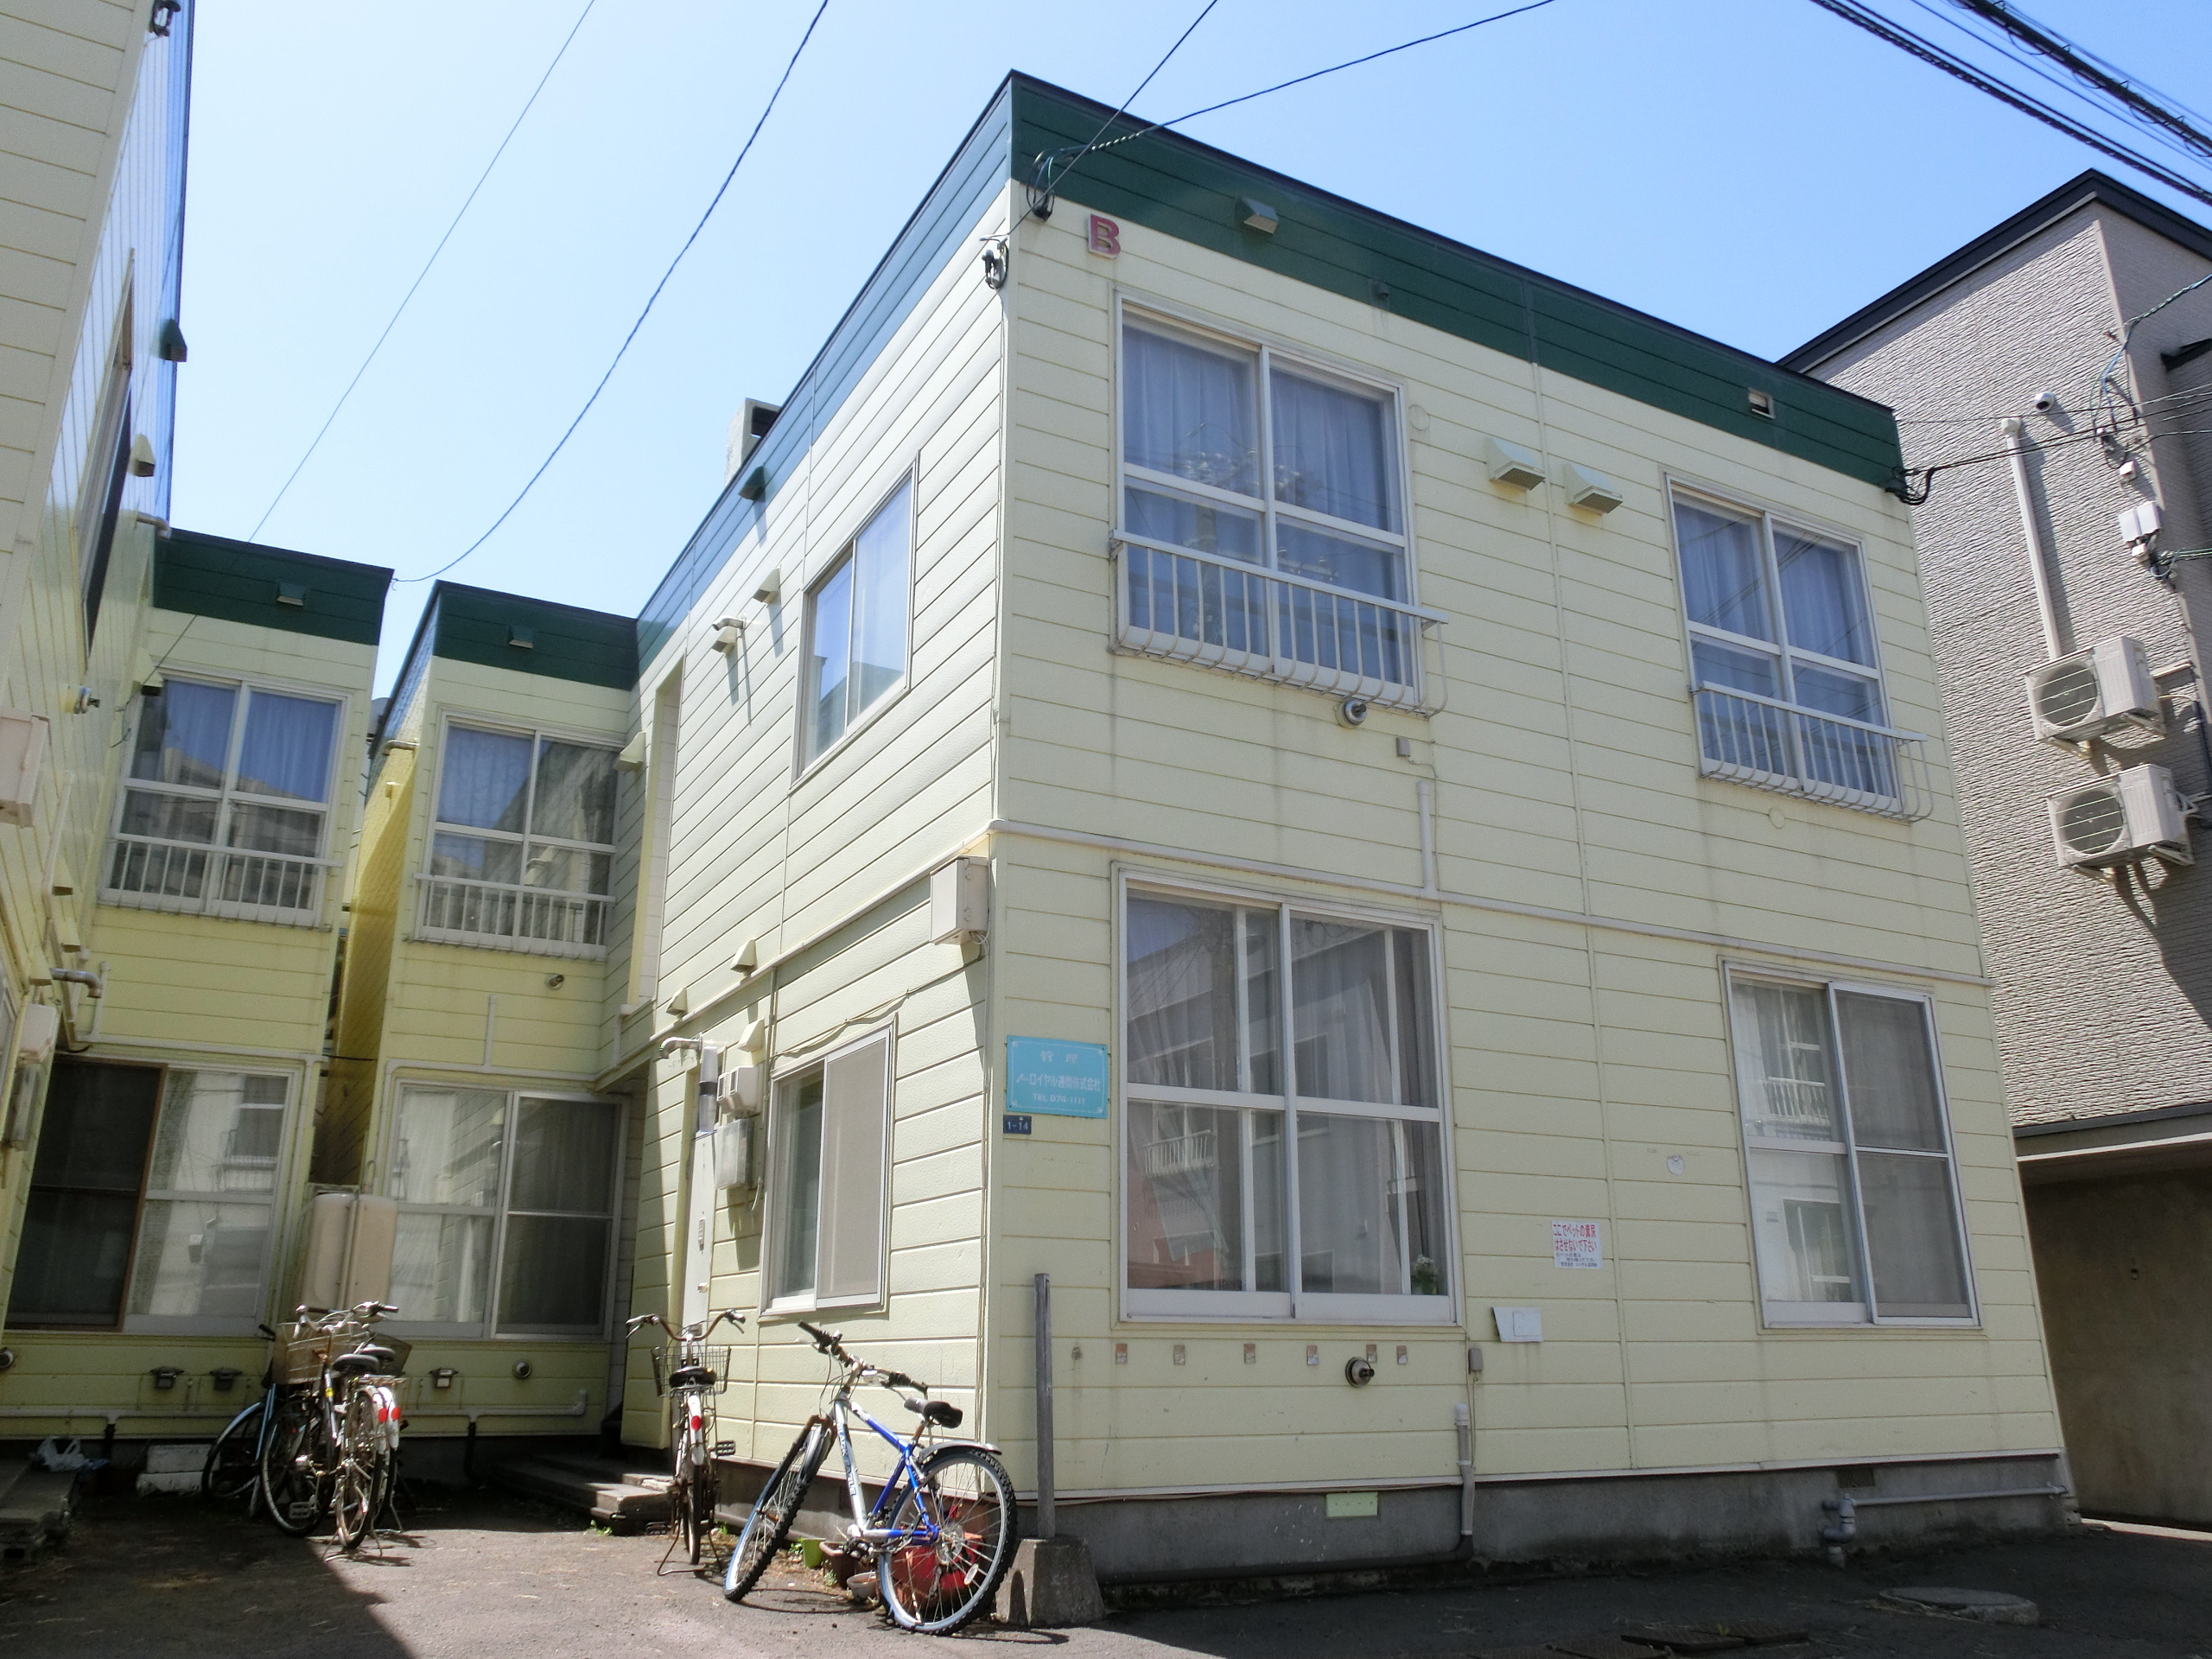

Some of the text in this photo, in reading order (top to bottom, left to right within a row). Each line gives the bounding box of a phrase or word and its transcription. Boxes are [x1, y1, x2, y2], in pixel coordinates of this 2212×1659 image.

[1088, 213, 1121, 258] B
[1033, 1093, 1048, 1102] TEL
[1006, 1121, 1029, 1131] 1-14
